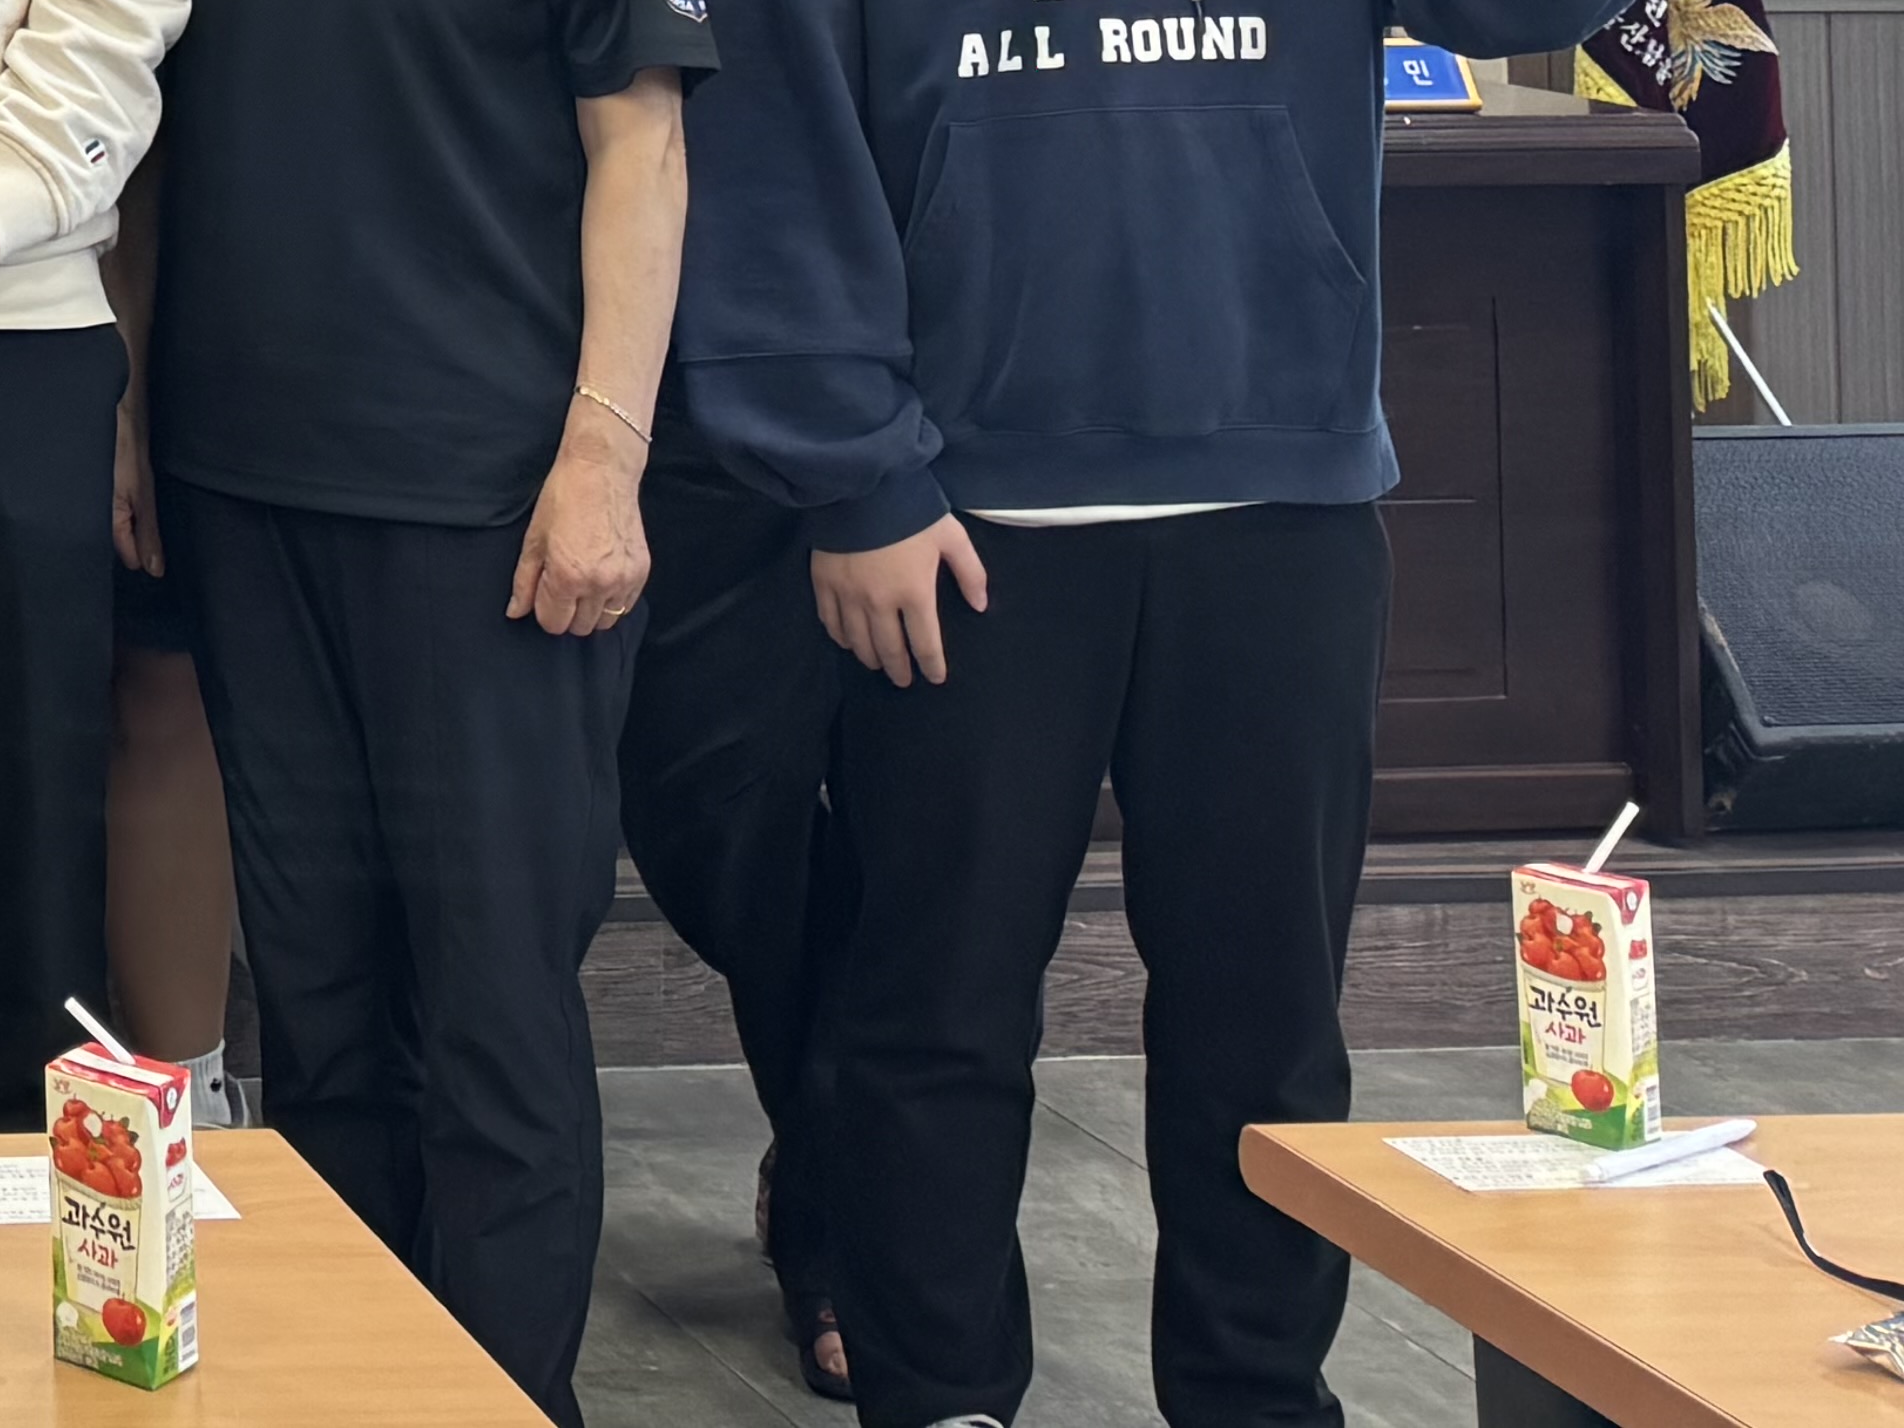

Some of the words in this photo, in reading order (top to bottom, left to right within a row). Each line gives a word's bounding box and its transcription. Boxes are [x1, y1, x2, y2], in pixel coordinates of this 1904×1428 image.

[958, 25, 1064, 78] ALL
[1099, 16, 1267, 63] ROUND
[1528, 985, 1601, 1028] 과수원
[1545, 1021, 1586, 1044] 사과
[61, 1196, 136, 1251] 과수원
[78, 1238, 119, 1270] 사과
